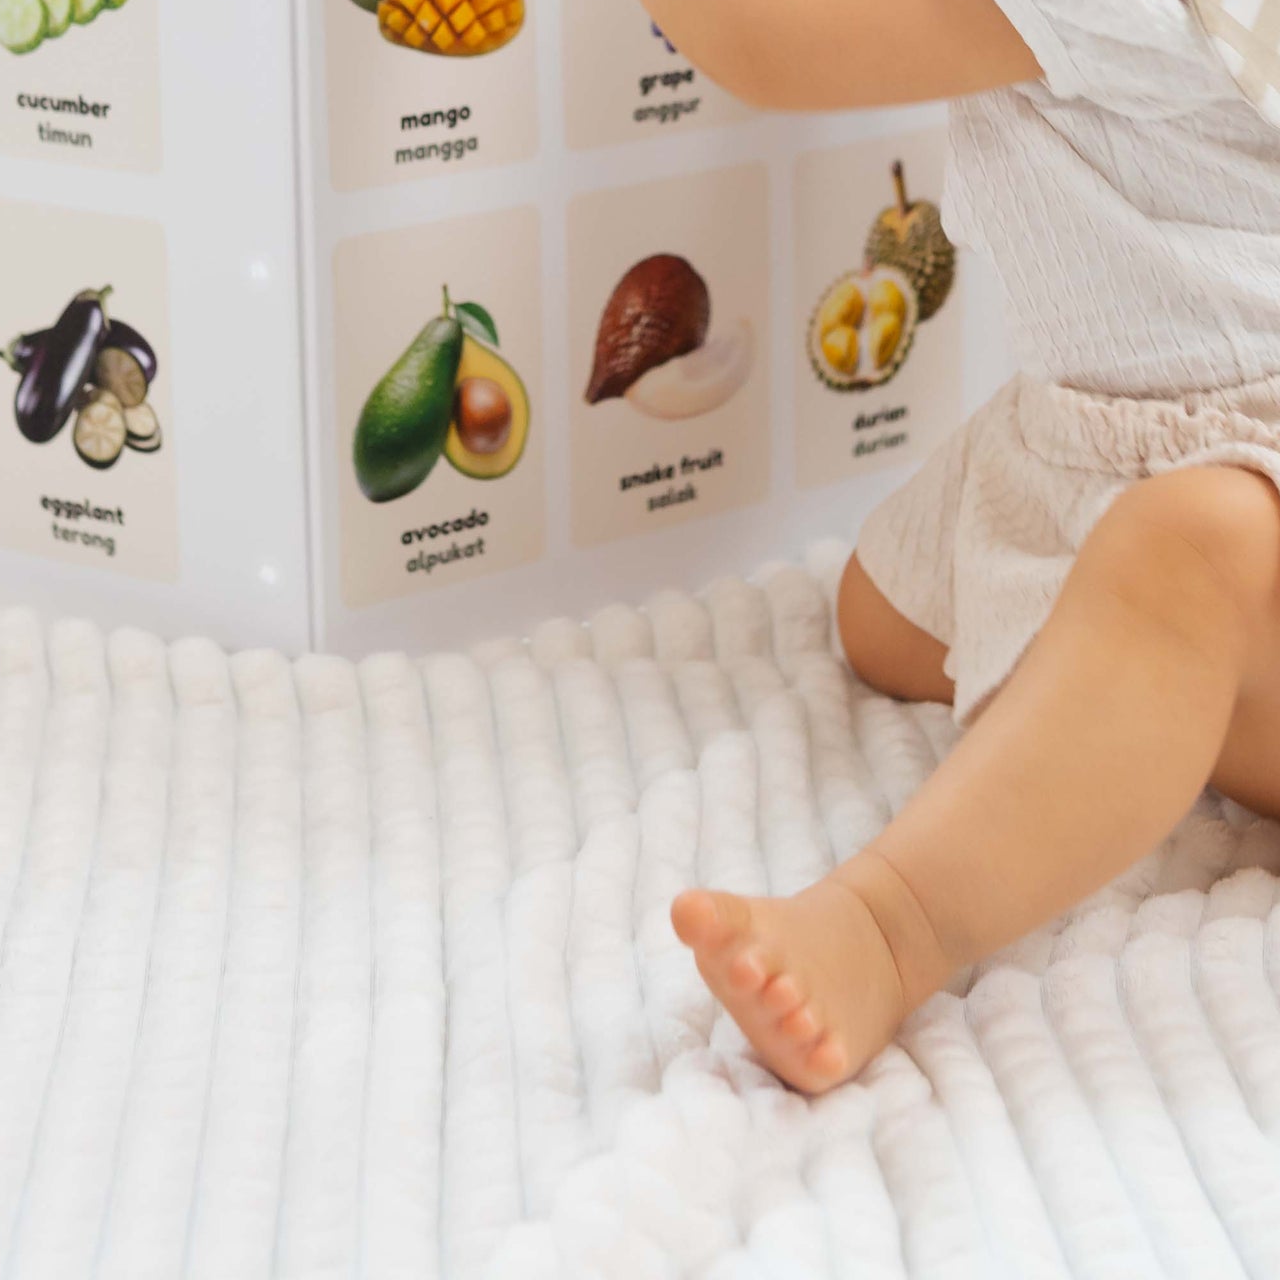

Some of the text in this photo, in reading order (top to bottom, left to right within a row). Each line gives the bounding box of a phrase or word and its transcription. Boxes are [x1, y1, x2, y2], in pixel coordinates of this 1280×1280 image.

[638, 68, 695, 97] grape
[16, 93, 111, 119] cucumber
[400, 105, 472, 131] mango
[632, 97, 702, 125] anggur
[36, 121, 93, 149] timun
[394, 136, 479, 165] mangga
[851, 405, 908, 432] durian
[851, 431, 909, 459] durian
[679, 449, 724, 476] fruit
[39, 495, 124, 526] eggplant
[51, 521, 117, 558] terong
[400, 508, 490, 546] avocado
[405, 537, 485, 574] alpukat
